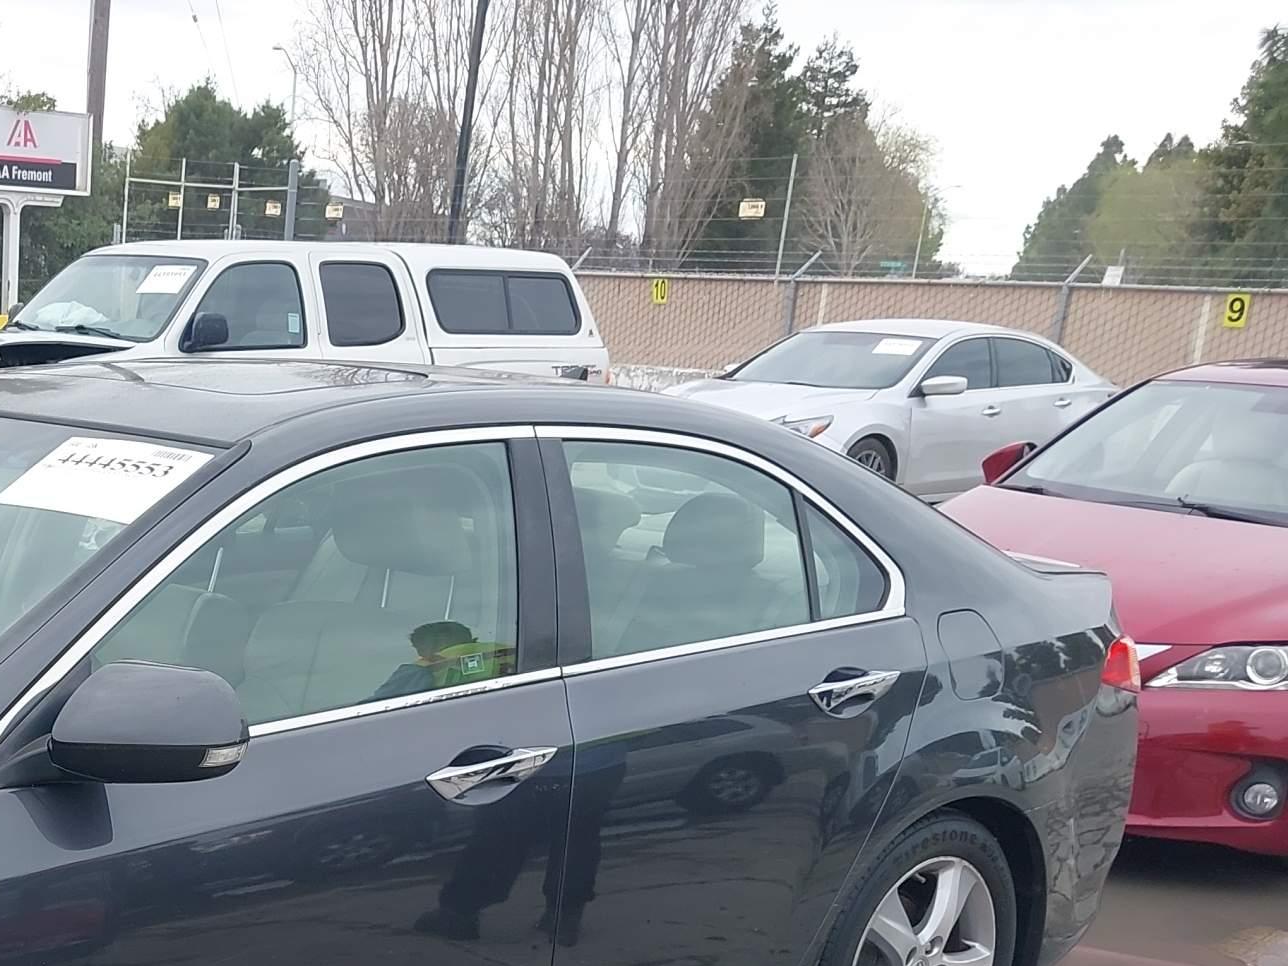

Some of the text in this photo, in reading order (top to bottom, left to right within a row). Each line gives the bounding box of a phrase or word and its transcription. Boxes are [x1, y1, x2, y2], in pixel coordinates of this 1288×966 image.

[12, 165, 53, 183] Fremont
[654, 279, 666, 300] 10
[1227, 297, 1246, 322] 9
[57, 452, 174, 478] 44445553
